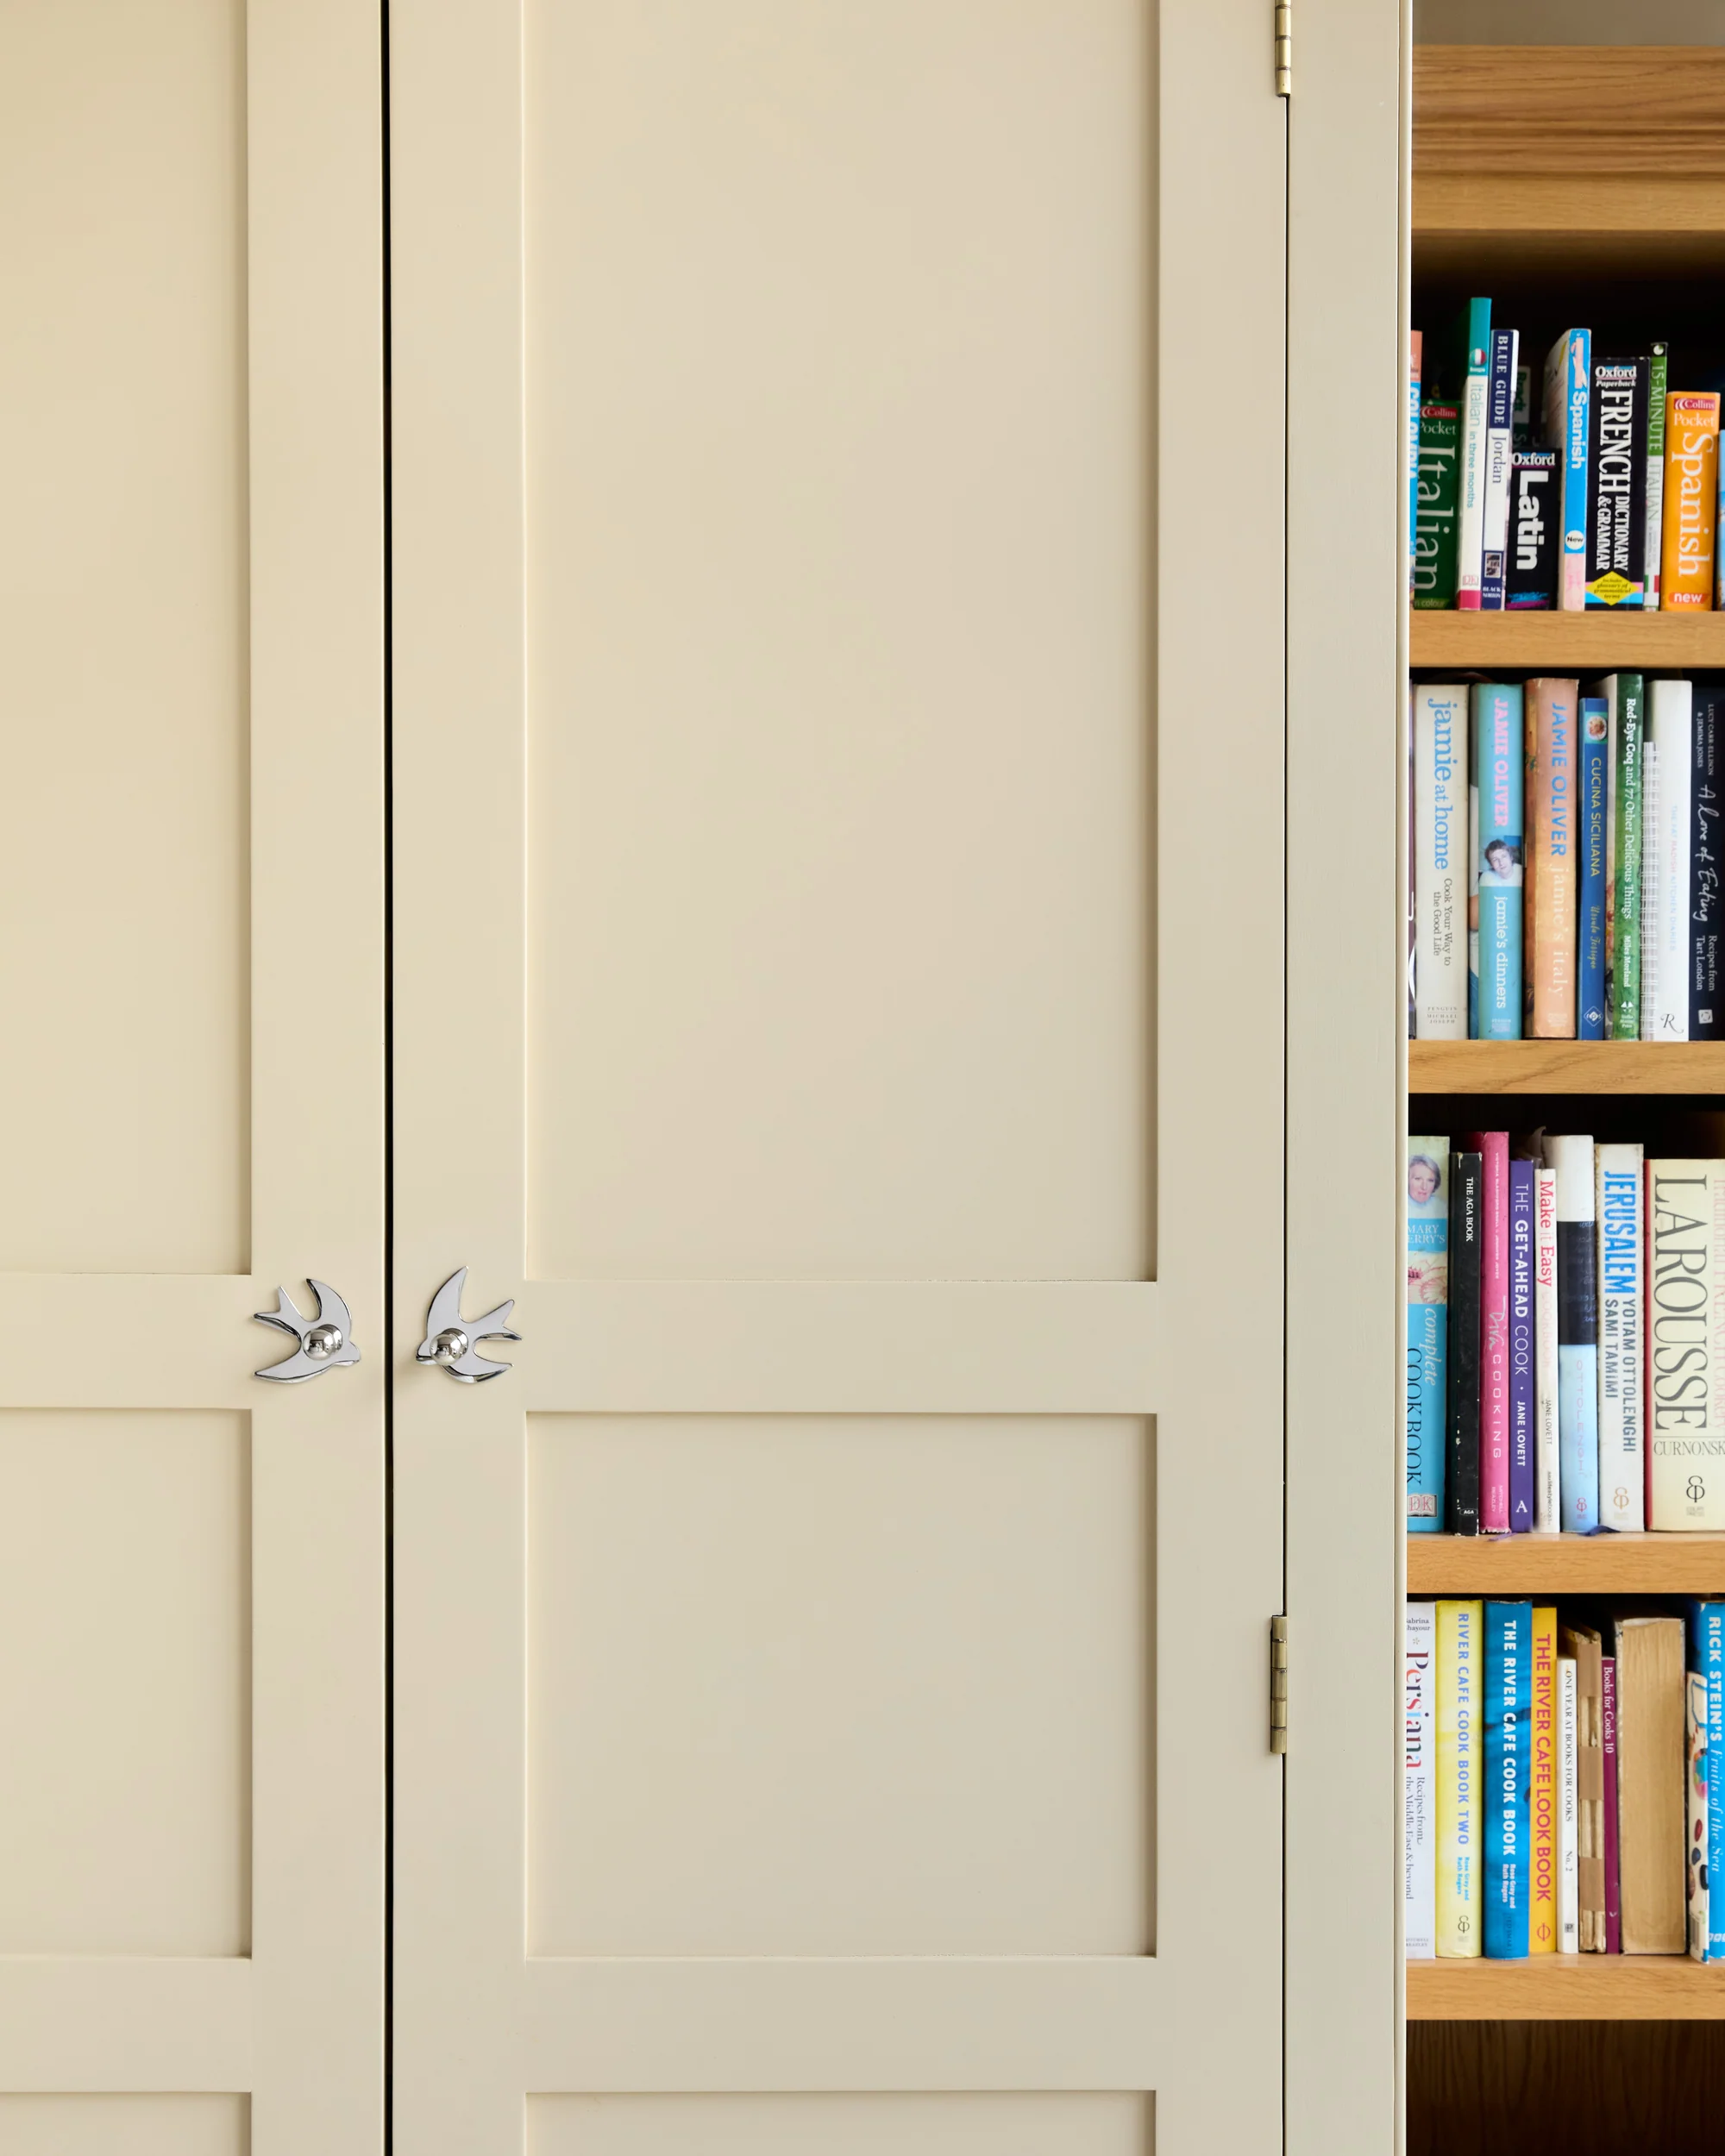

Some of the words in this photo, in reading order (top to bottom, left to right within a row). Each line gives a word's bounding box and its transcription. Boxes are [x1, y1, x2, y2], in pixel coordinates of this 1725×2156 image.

[1496, 335, 1509, 373] BLUE
[1595, 366, 1637, 378] Oxford
[1494, 379, 1506, 423] GUIDE
[1596, 379, 1636, 388] Paperback
[1427, 408, 1457, 417] Collins
[1470, 384, 1484, 427] Italian
[1649, 365, 1665, 450] 15-MINUTE
[1674, 413, 1715, 427] Pocket
[1684, 399, 1715, 409] Collins
[1469, 431, 1476, 440] in
[1570, 392, 1588, 469] Spanish
[1599, 389, 1633, 494] FRENCH
[1491, 436, 1506, 484] Jordan
[1512, 452, 1555, 466] Oxford
[1647, 464, 1661, 521] ITALIAN
[1672, 432, 1715, 577] Spanish
[1414, 445, 1455, 590] Italian
[1516, 471, 1549, 569] Latin
[1614, 496, 1630, 571] DICTIONARY
[1596, 508, 1611, 571] GRAMMAR
[1673, 592, 1703, 603] new
[1494, 698, 1509, 755] JAMIE
[1552, 702, 1567, 767] JAMIE
[1623, 698, 1637, 741] Red-Eye
[1427, 699, 1458, 782] jamie
[1623, 743, 1635, 764] Coq
[1435, 785, 1449, 802] at
[1494, 760, 1509, 827] OLIVER
[1590, 757, 1602, 809] CUCINA
[1624, 787, 1634, 801] 77
[1626, 768, 1636, 787] and
[1697, 784, 1716, 799] A
[1551, 776, 1567, 856] OLIVER
[1625, 801, 1635, 832] Other
[1697, 803, 1719, 842] love
[1434, 805, 1453, 870] home
[1590, 812, 1602, 877] SICILIANA
[1695, 845, 1715, 862] of
[1624, 834, 1635, 883] Delicious
[1433, 892, 1442, 907] the
[1444, 878, 1453, 903] Cook
[1549, 864, 1569, 942] jamie's
[1621, 884, 1634, 919] Things
[1692, 867, 1718, 922] Eating
[1433, 912, 1442, 934] Good
[1444, 906, 1453, 931] Your
[1494, 896, 1509, 949] jamie's
[1433, 937, 1442, 956] Life
[1442, 933, 1453, 956] Way
[1696, 936, 1705, 955] Tart
[1706, 935, 1717, 968] Recipes
[1496, 952, 1509, 1009] dinners
[1547, 950, 1568, 998] italy
[1623, 956, 1632, 987] Morland
[1696, 956, 1705, 991] London
[1708, 970, 1717, 991] from
[1660, 1013, 1684, 1034] R
[1515, 1184, 1528, 1213] THE
[1540, 1181, 1555, 1229] Make
[1408, 1225, 1439, 1233] MARY
[1541, 1232, 1554, 1242] it
[1603, 1171, 1636, 1294] JERUSALEM
[1515, 1220, 1528, 1318] GET-AHEAD
[1537, 1246, 1555, 1287] Easy
[1653, 1174, 1709, 1431] LAROUSSE
[1622, 1299, 1636, 1351] YOTAM
[1419, 1307, 1441, 1386] complete
[1515, 1325, 1528, 1376] COOK
[1407, 1348, 1422, 1485] COOKBOOK
[1493, 1354, 1502, 1458] COOKING
[1517, 1401, 1526, 1426] JANE
[1622, 1357, 1636, 1452] OTTOLENGHI
[1517, 1429, 1526, 1467] LOVETT
[1408, 1496, 1433, 1511] DK
[1515, 1501, 1527, 1513] A
[1458, 1614, 1470, 1660] RIVER
[1503, 1620, 1516, 1651] THE
[1536, 1634, 1551, 1670] THE
[1709, 1617, 1722, 1663] RICK
[1458, 1666, 1470, 1703] CAFE
[1503, 1658, 1516, 1707] RIVER
[1603, 1667, 1614, 1694] Books
[1407, 1651, 1429, 1769] Persiana
[1536, 1677, 1551, 1731] RIVER
[1604, 1696, 1614, 1709] for
[1709, 1670, 1722, 1742] STEIN'S
[1458, 1710, 1470, 1752] COOK
[1503, 1713, 1516, 1752] CAFE
[1565, 1719, 1572, 1731] AT
[1604, 1712, 1615, 1739] Cooks
[1536, 1737, 1551, 1783] CAFE
[1565, 1733, 1573, 1765] BOOKS
[1604, 1742, 1615, 1754] 10
[1458, 1760, 1470, 1803] BOOK
[1503, 1758, 1516, 1803] COOK
[1710, 1749, 1722, 1791] Fruits
[1414, 1777, 1426, 1814] Recipes
[1709, 1798, 1723, 1814] of
[1416, 1815, 1426, 1845] from
[1458, 1810, 1470, 1845] TWO
[1503, 1809, 1516, 1856] BOOK
[1536, 1789, 1551, 1842] LOOK
[1711, 1817, 1723, 1840] the
[1536, 1847, 1551, 1902] BOOK
[1711, 1846, 1723, 1871] Sea
